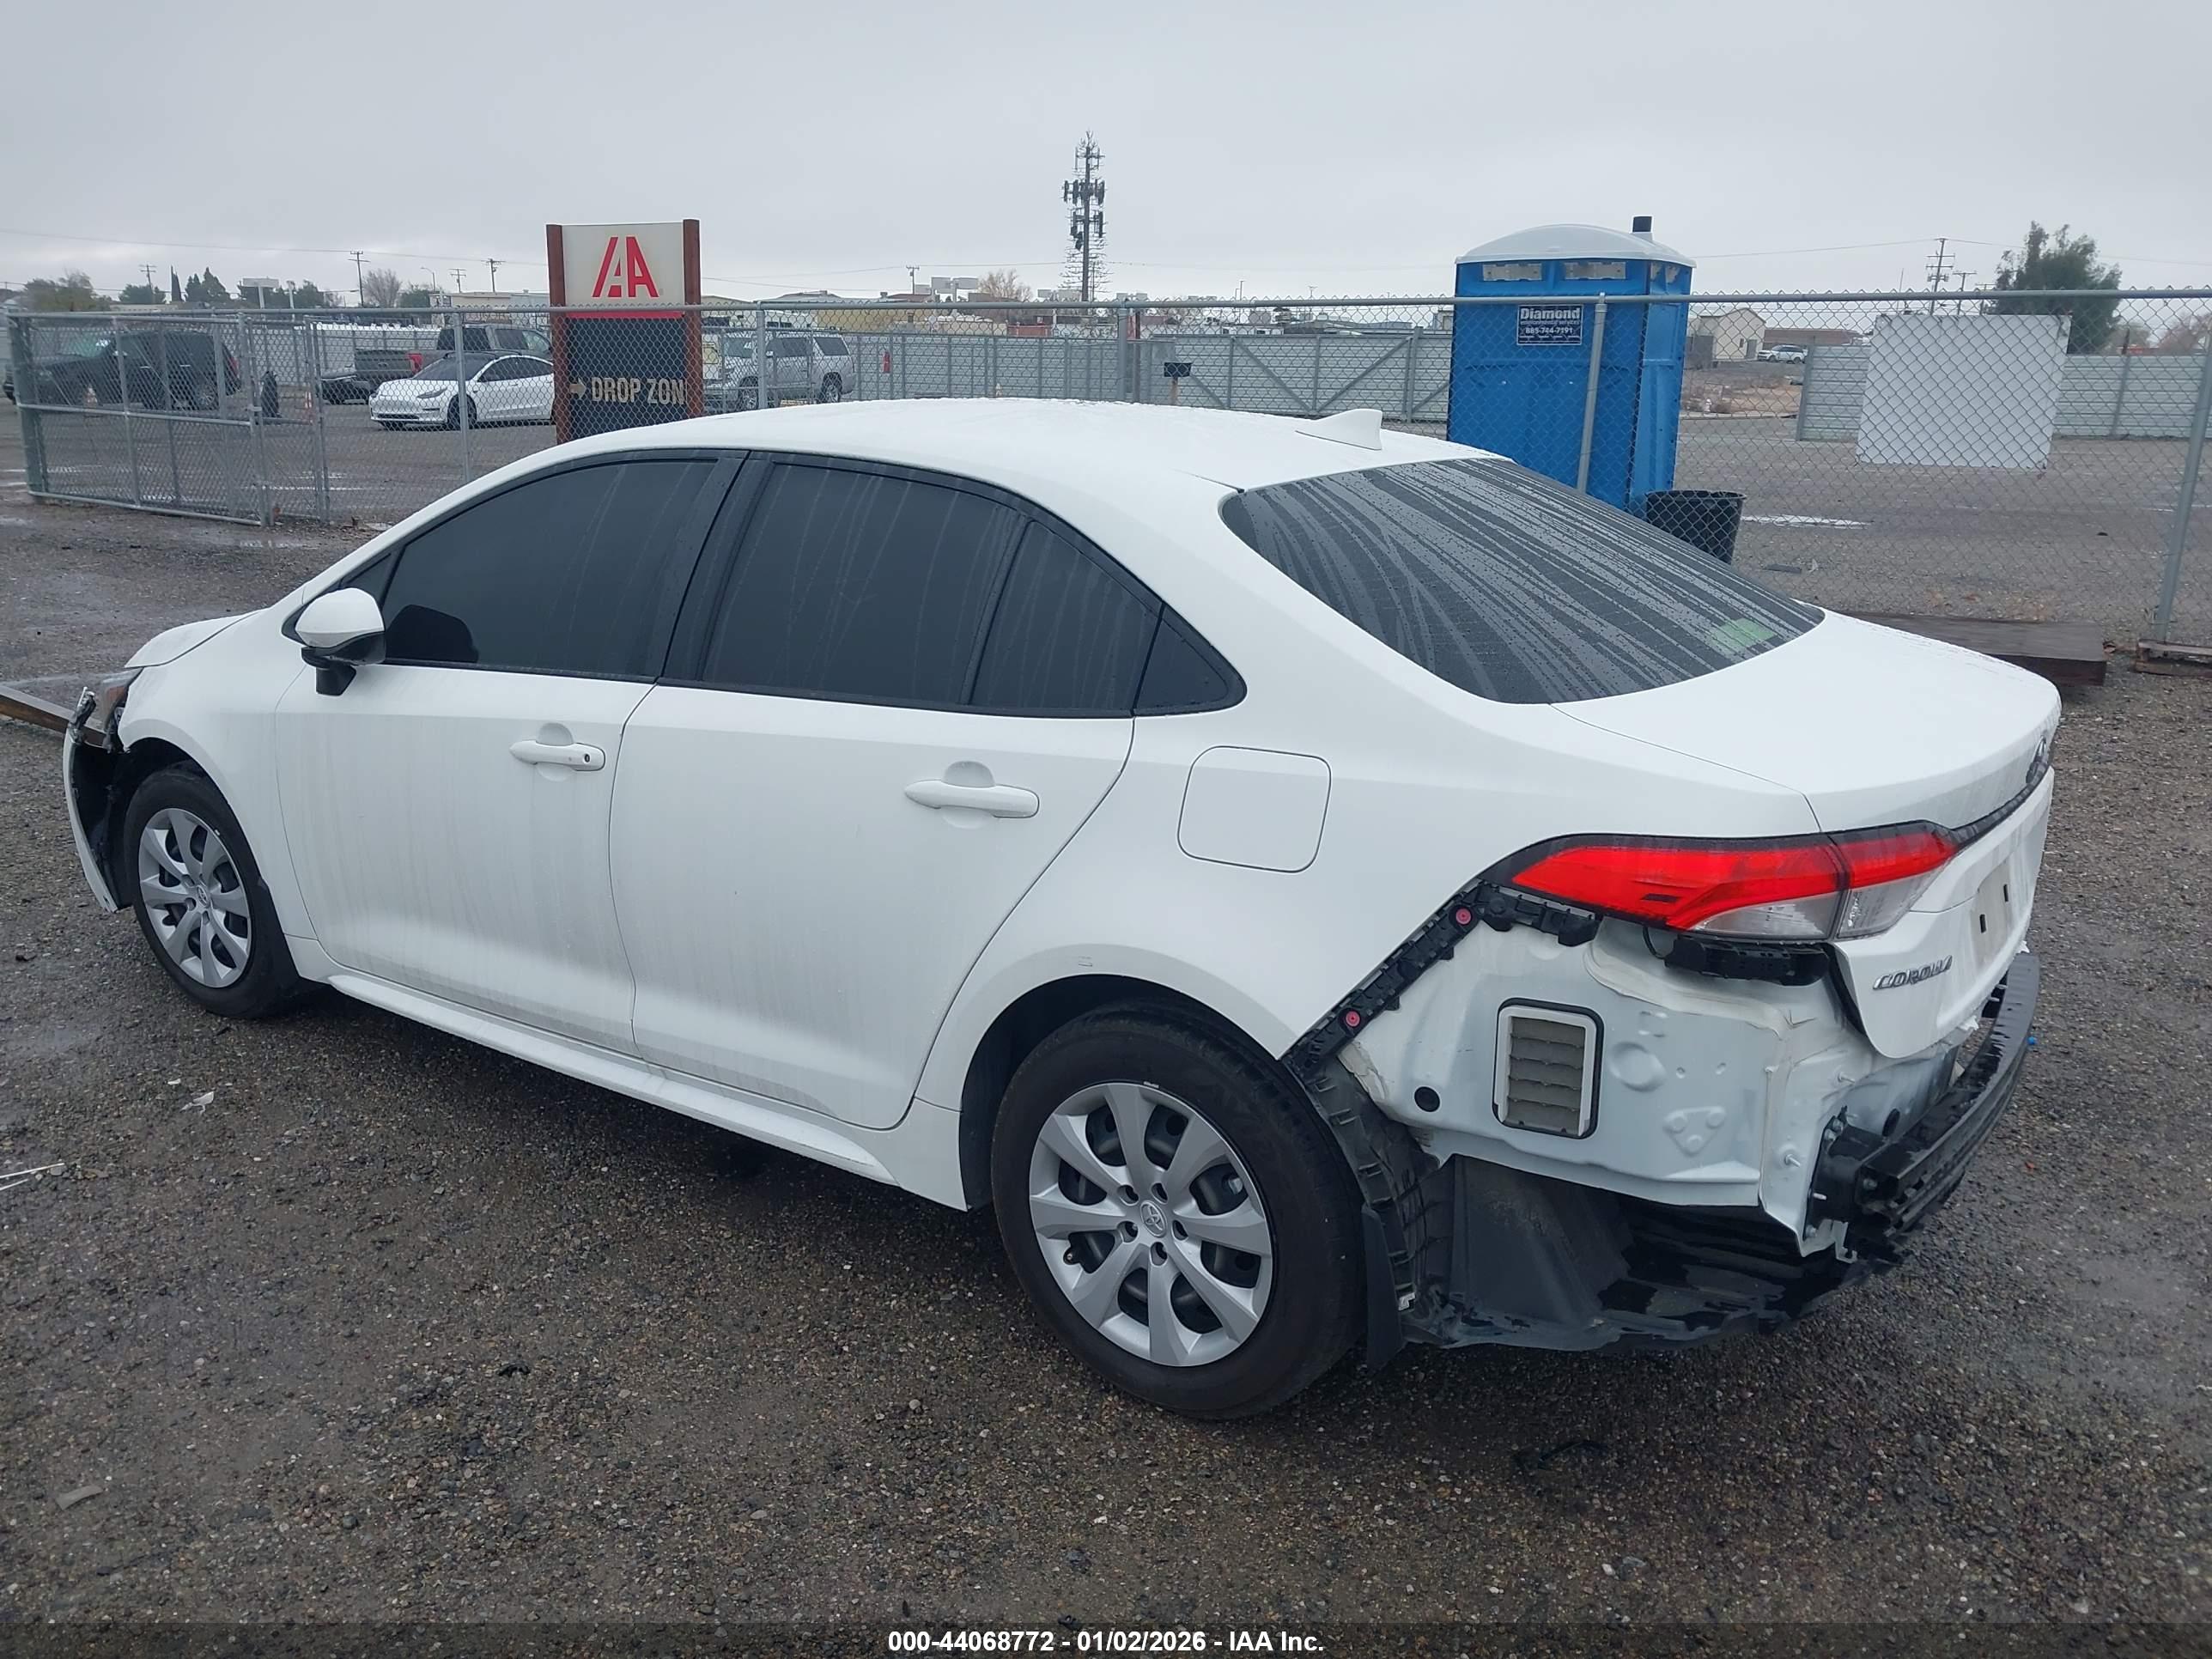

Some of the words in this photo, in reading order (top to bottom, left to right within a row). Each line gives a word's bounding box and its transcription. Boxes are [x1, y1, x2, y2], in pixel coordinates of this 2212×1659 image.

[1520, 307, 1580, 319] Diamond
[591, 377, 641, 404] DROP
[647, 378, 685, 405] ZON
[1872, 954, 1953, 991] COROLLA
